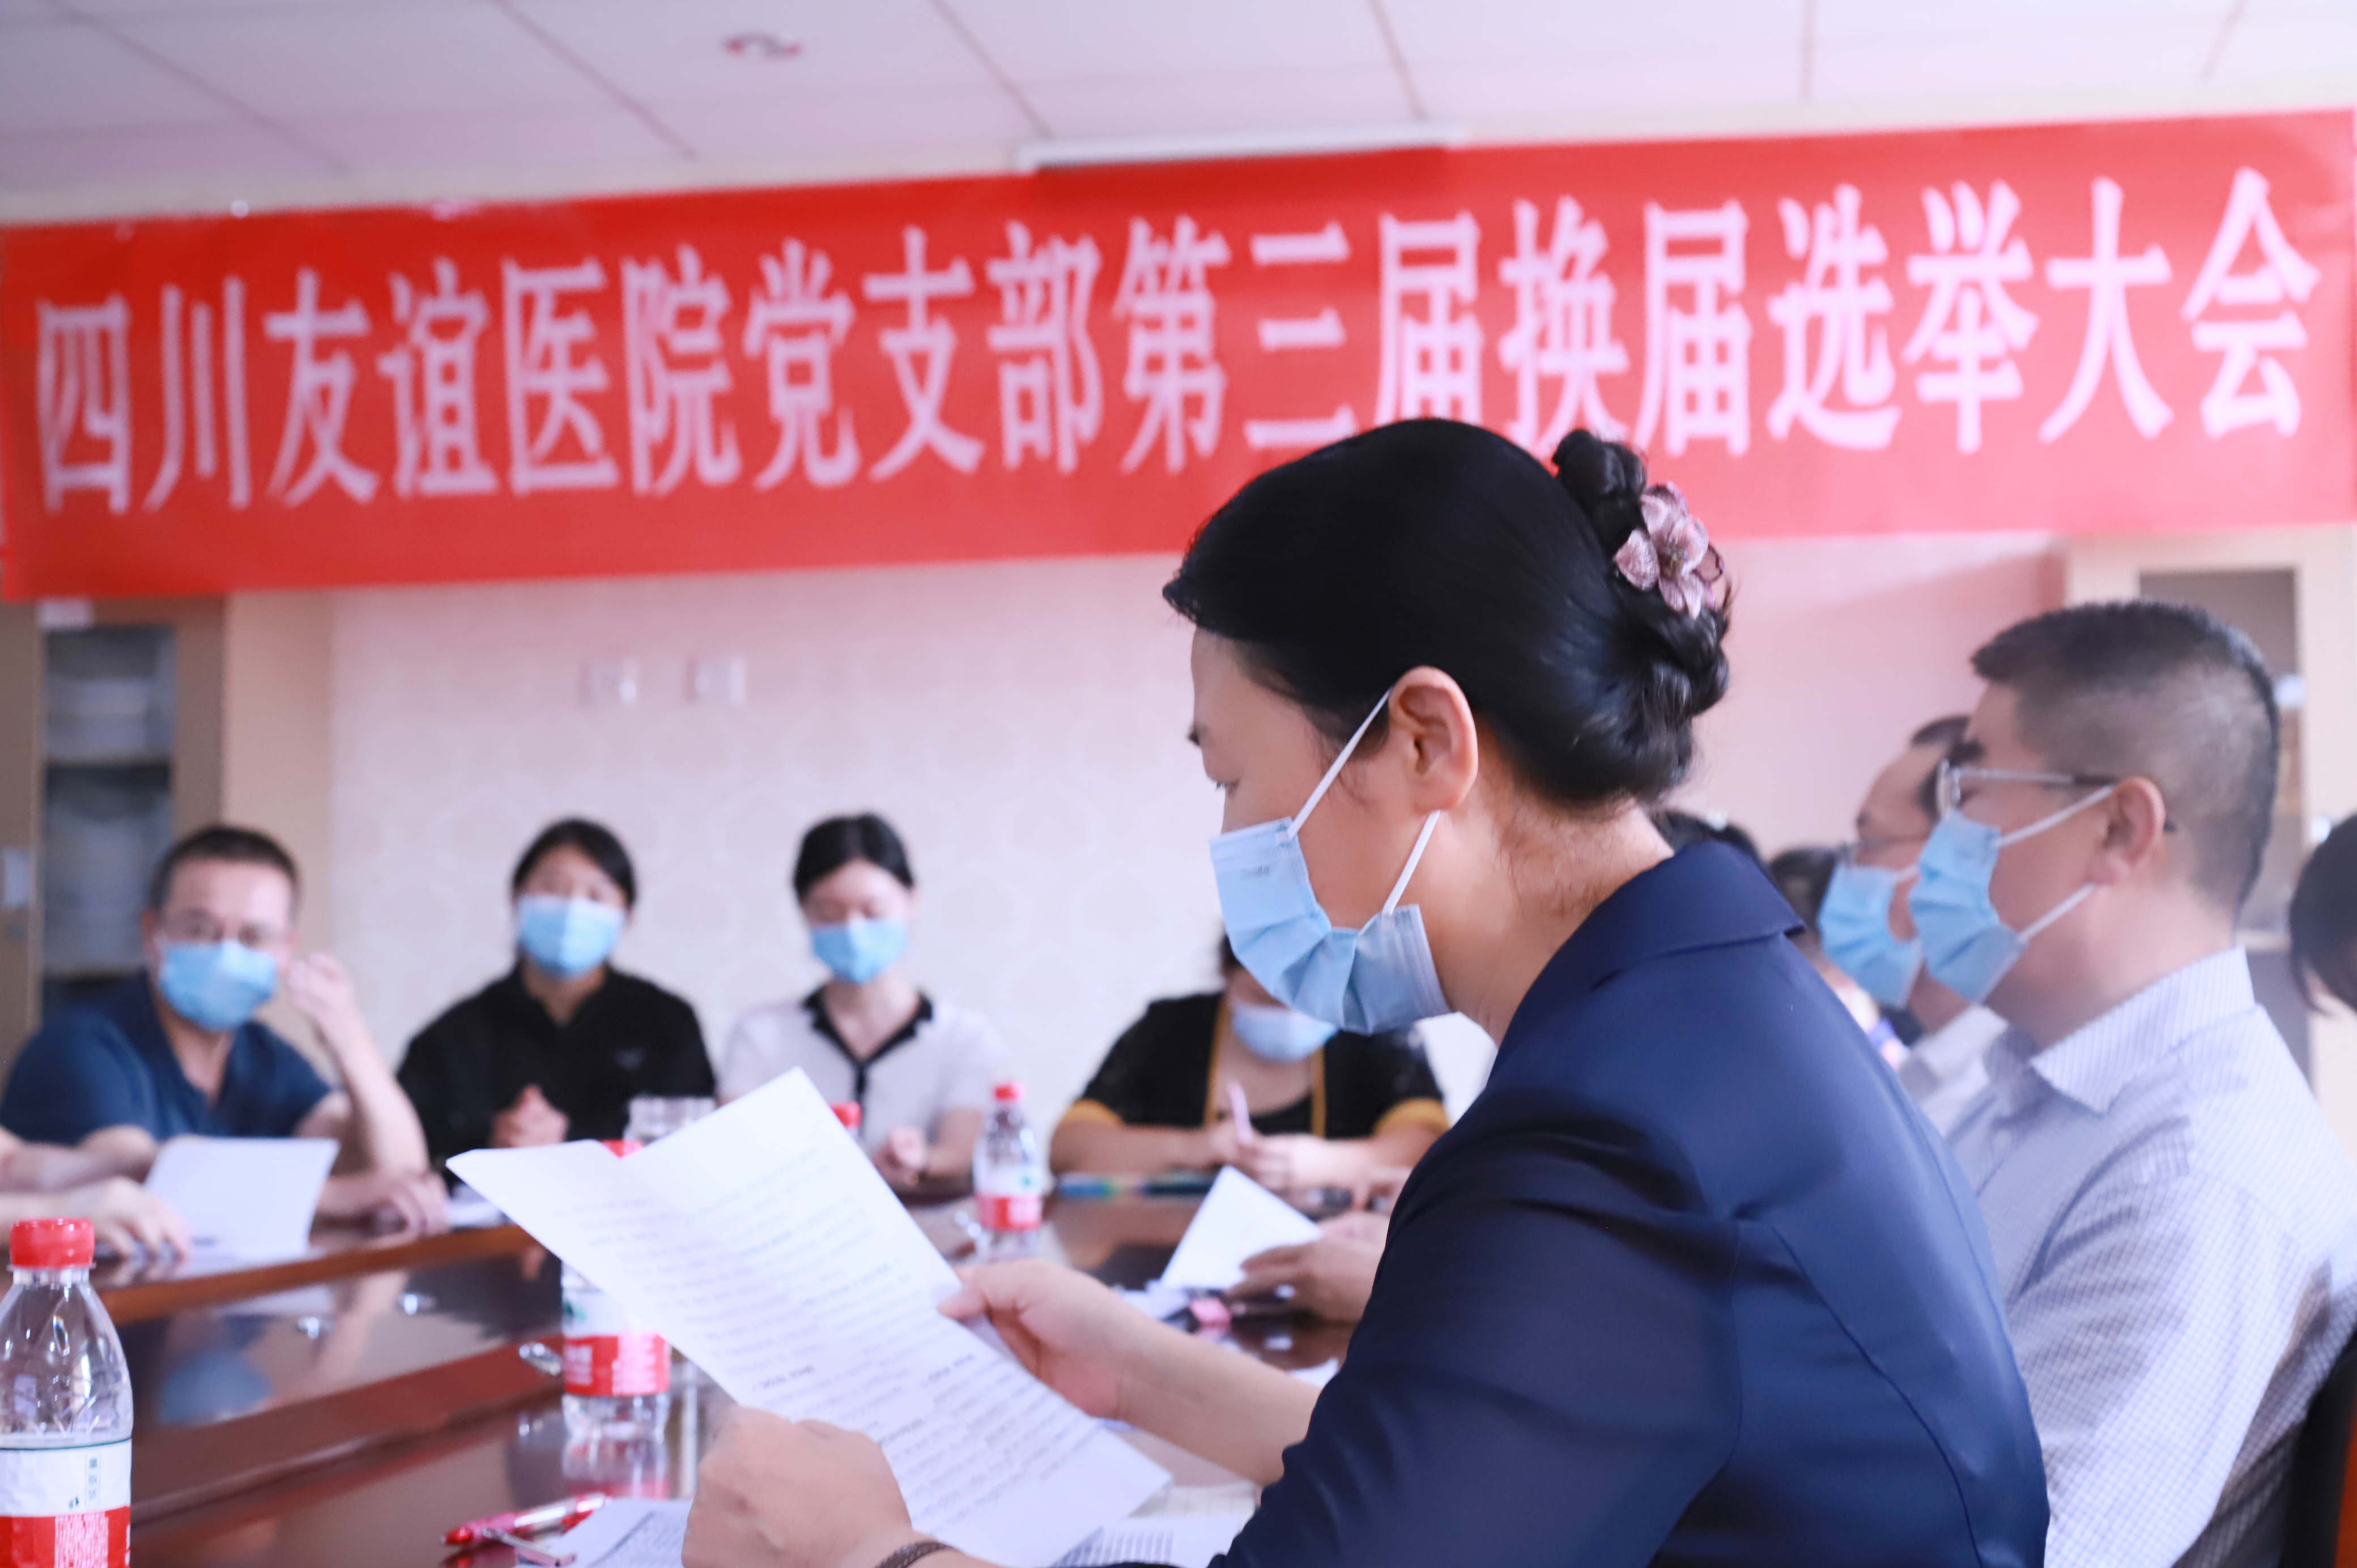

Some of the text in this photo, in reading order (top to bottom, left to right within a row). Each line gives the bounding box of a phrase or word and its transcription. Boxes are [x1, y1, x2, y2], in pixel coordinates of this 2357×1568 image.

[35, 167, 2320, 516] 四川友谊医院党支部第三届换届选举大会
